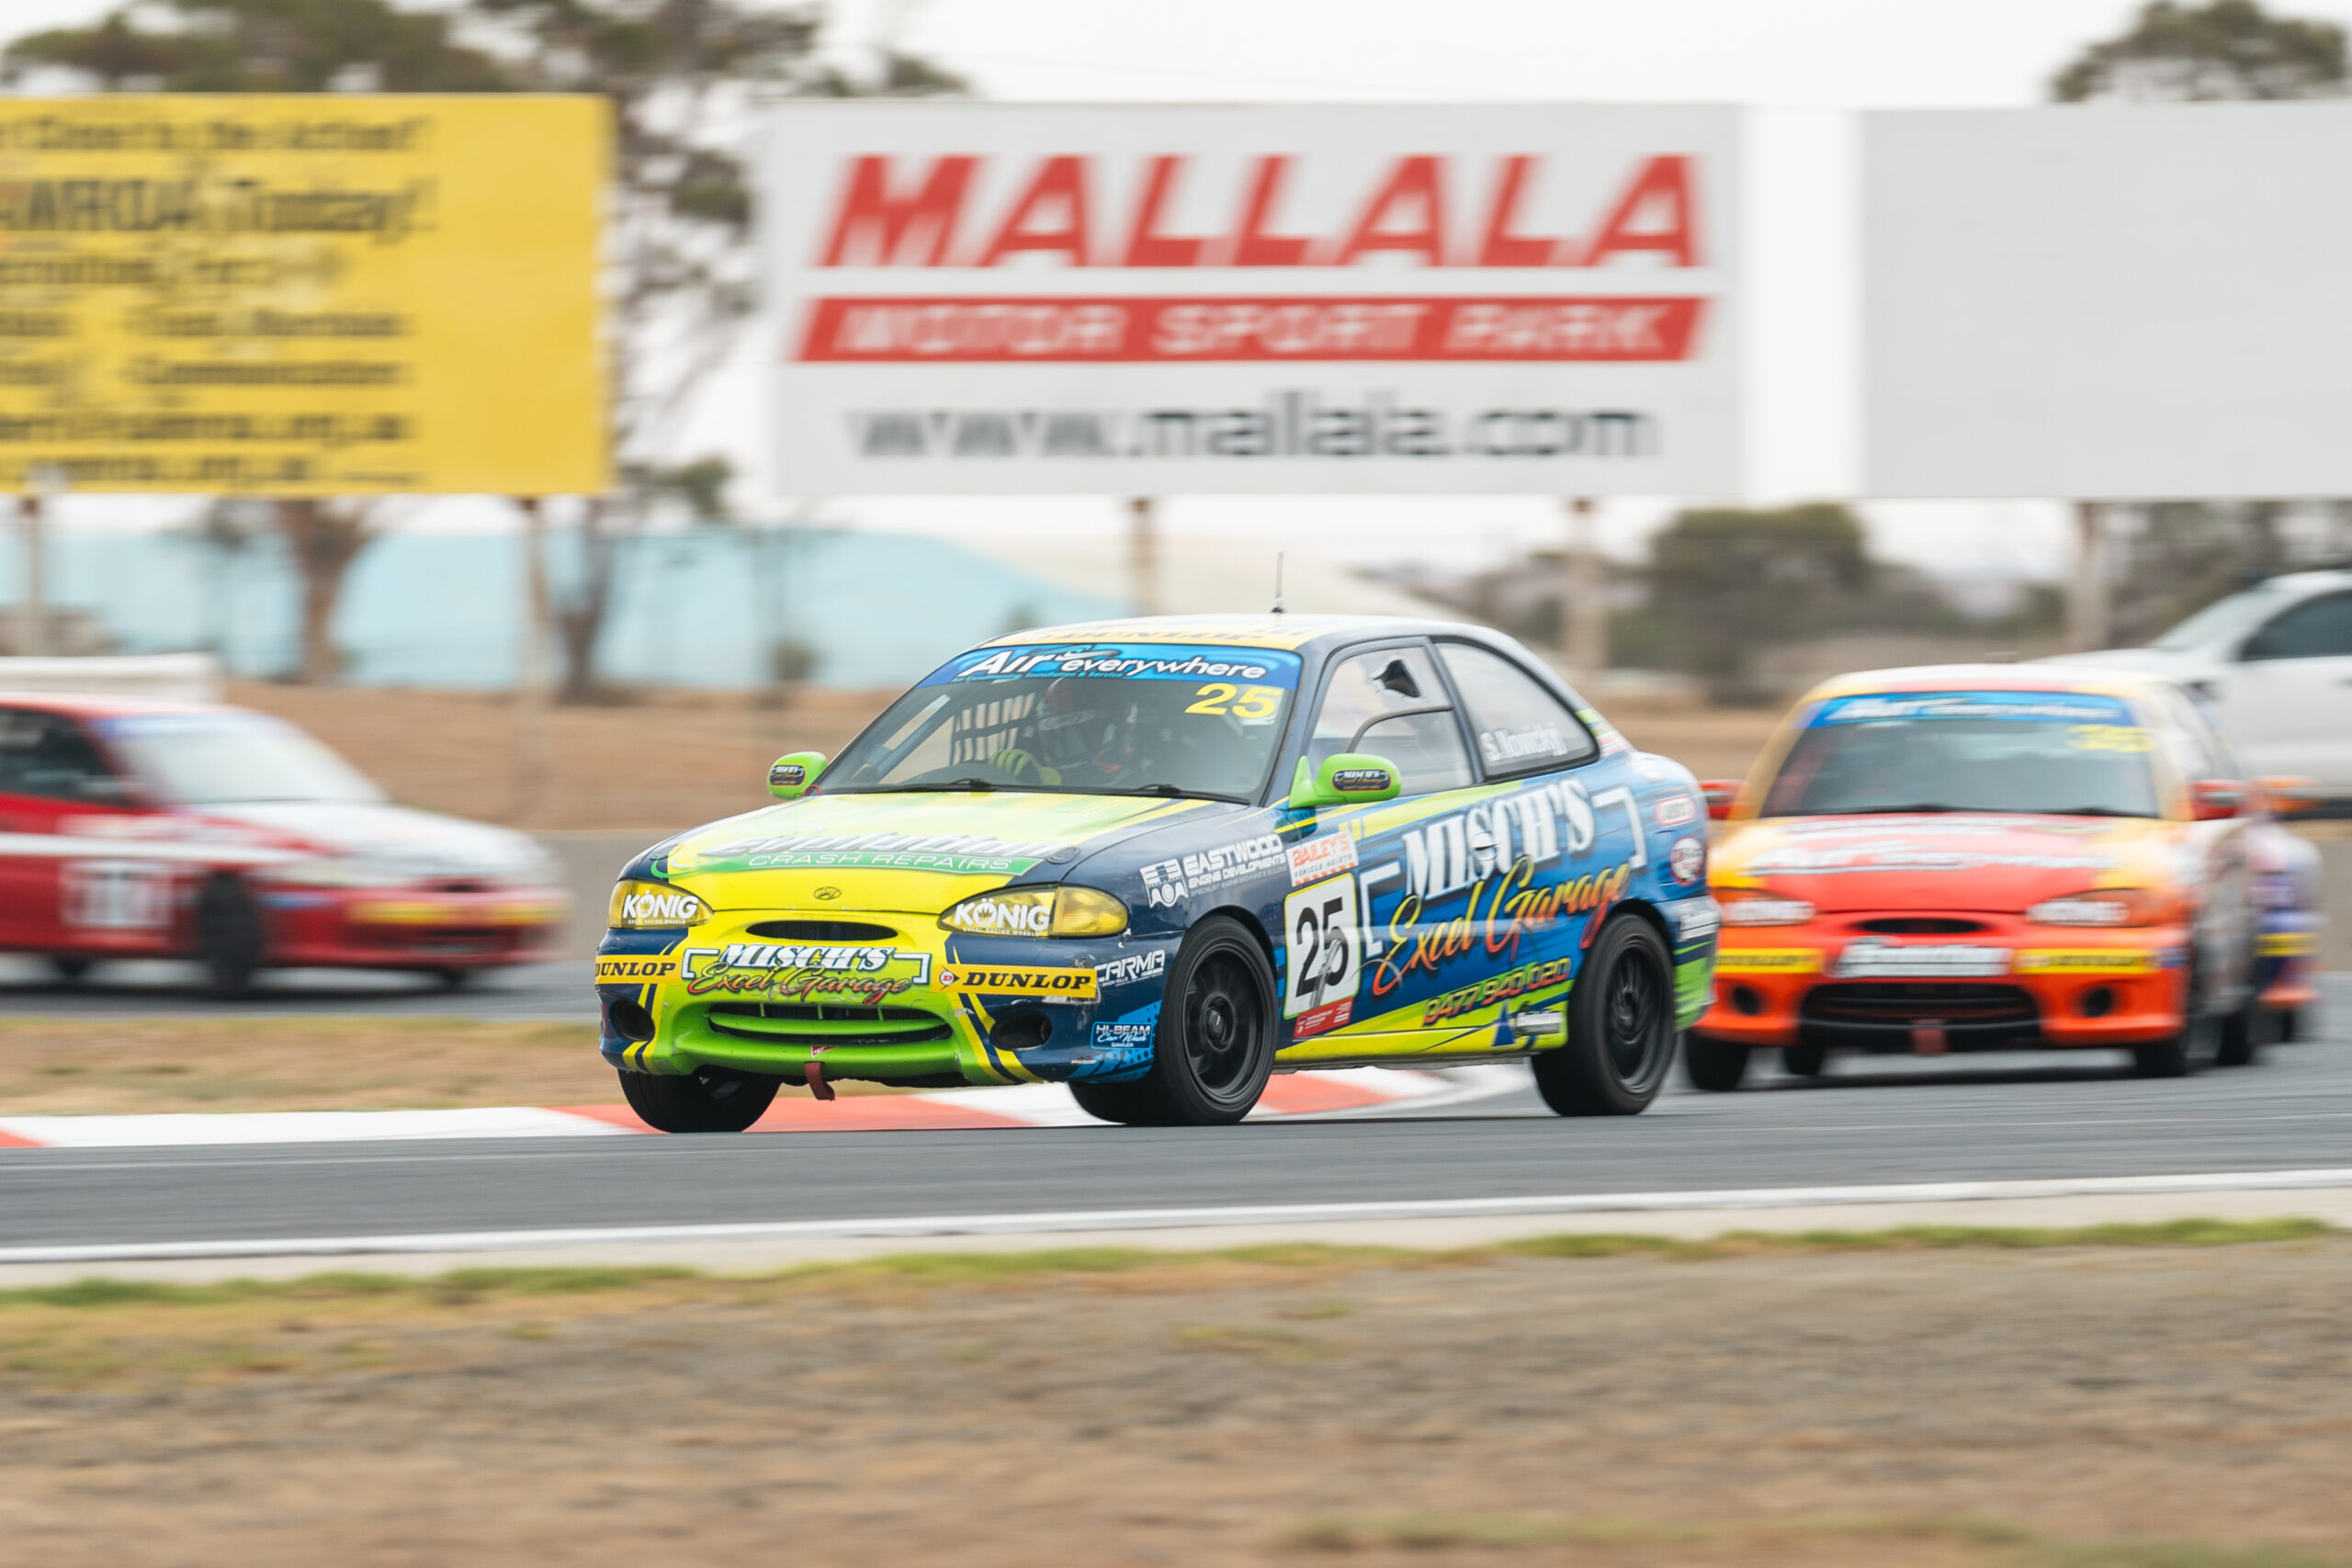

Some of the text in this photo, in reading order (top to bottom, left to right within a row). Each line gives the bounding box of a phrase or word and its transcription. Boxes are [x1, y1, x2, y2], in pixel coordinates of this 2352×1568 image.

[814, 152, 1711, 269] MALLALA
[832, 303, 1676, 355] MOTOR SPORT PARK
[845, 389, 1663, 458] www.mallala.com
[958, 650, 1269, 681] Air everywhere
[1184, 682, 1284, 719] 25
[1183, 834, 1283, 877] EASTWOOD
[1402, 777, 1595, 901] MISCH'S
[748, 853, 1013, 870] CRASH REPAIRS
[1188, 853, 1286, 888] ENGINE DEVELOPMENTS
[955, 897, 1050, 931] KÖNIG
[1373, 879, 1486, 995] Excel
[1485, 855, 1632, 962] Garage
[719, 943, 897, 972] MISCH'S
[1094, 949, 1165, 980] CARMA
[1295, 897, 1349, 998] 25
[595, 962, 676, 976] DUNLOP
[688, 962, 912, 1005] Excel Garage
[963, 972, 1091, 989] DUNLOP
[1423, 986, 1481, 1023] 0477
[1480, 971, 1525, 1005] 940
[1096, 1024, 1151, 1035] HI-BEAM
[1097, 1032, 1118, 1043] Car
